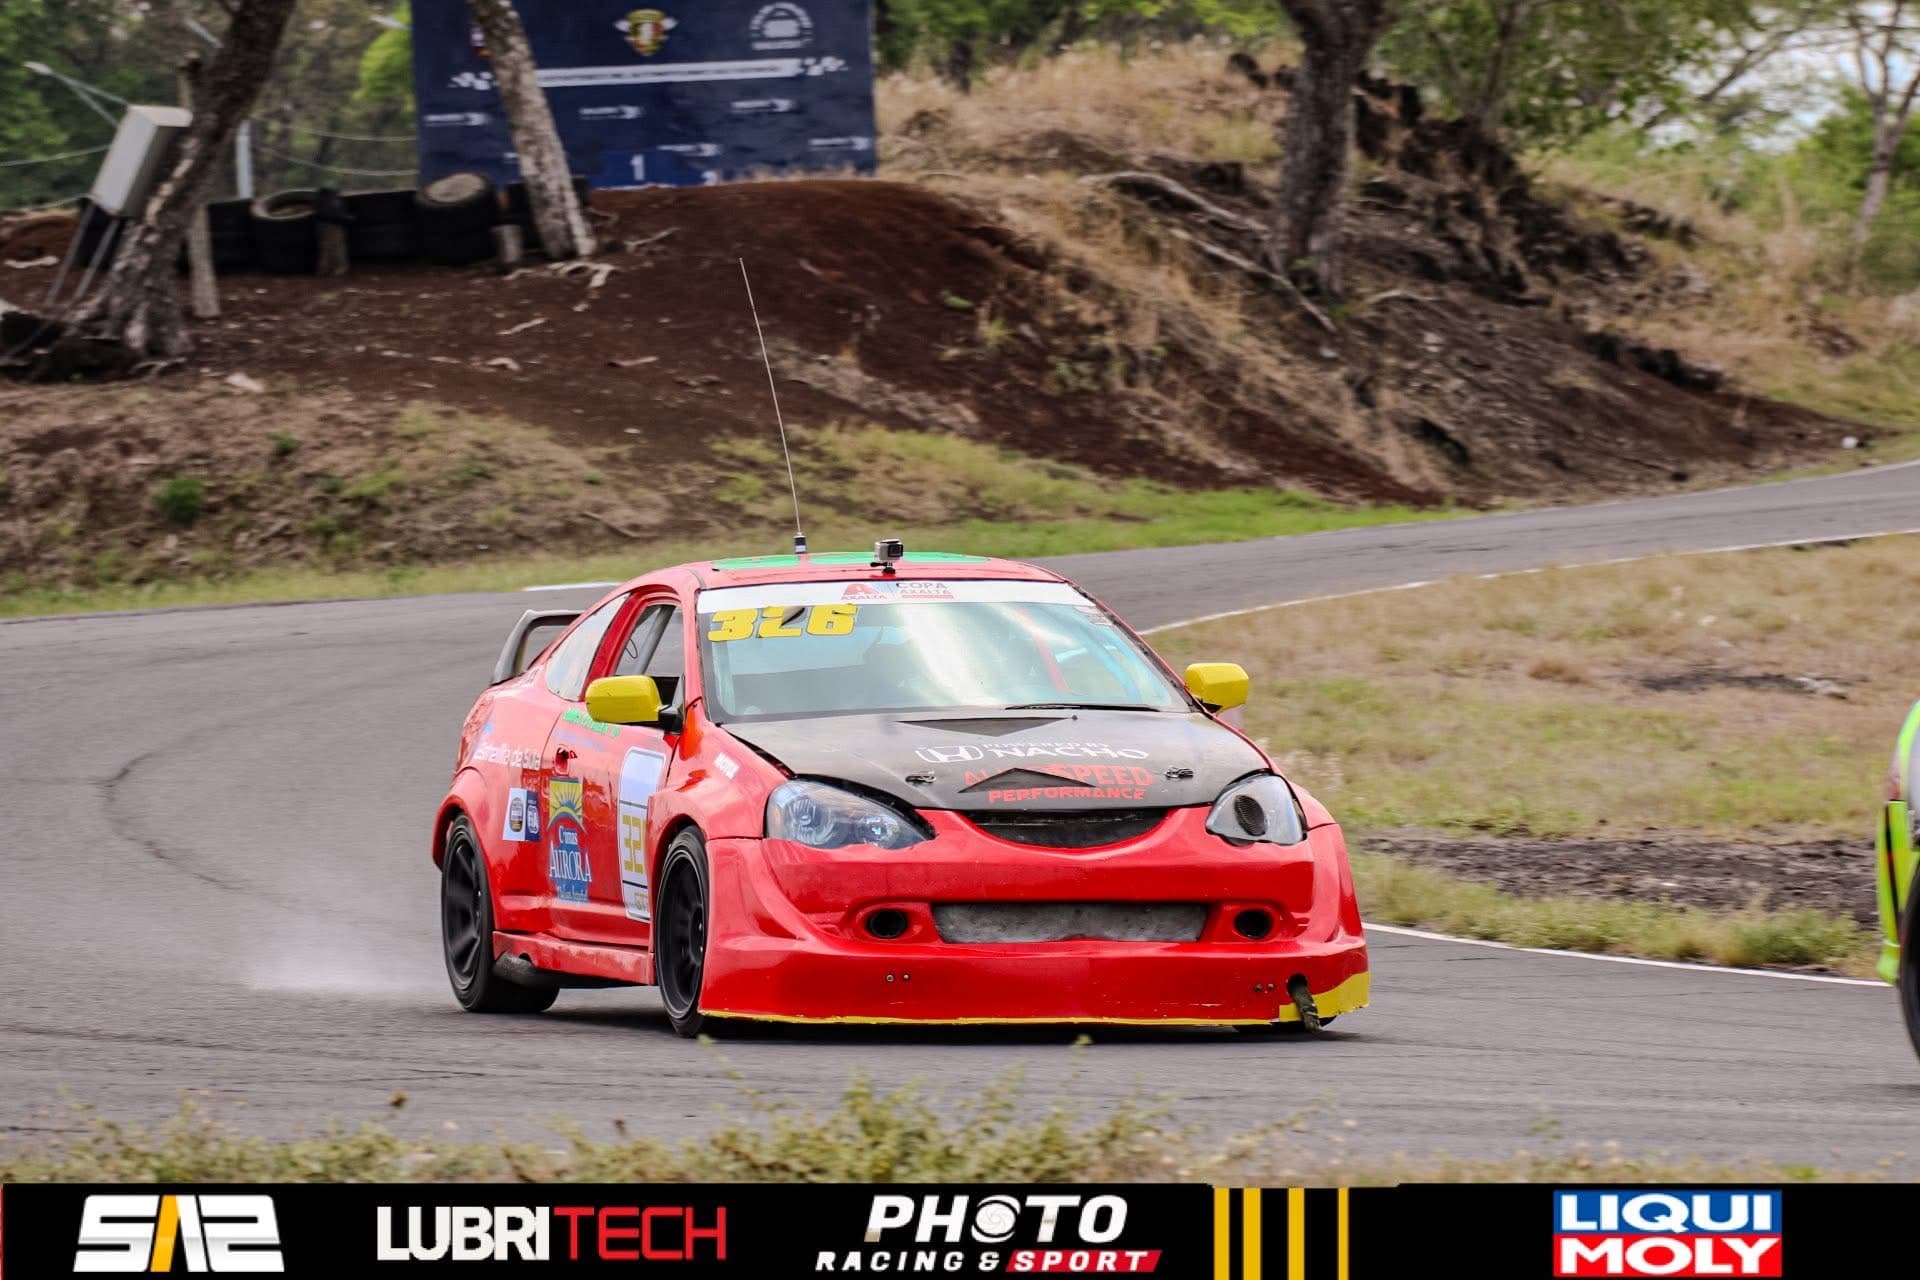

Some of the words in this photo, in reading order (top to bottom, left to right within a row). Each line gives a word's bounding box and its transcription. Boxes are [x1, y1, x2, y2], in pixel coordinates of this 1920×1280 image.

[707, 603, 858, 642] 326
[986, 747, 1150, 760] NACHO
[988, 786, 1147, 804] PERFORMANCE
[549, 839, 592, 882] AURORA
